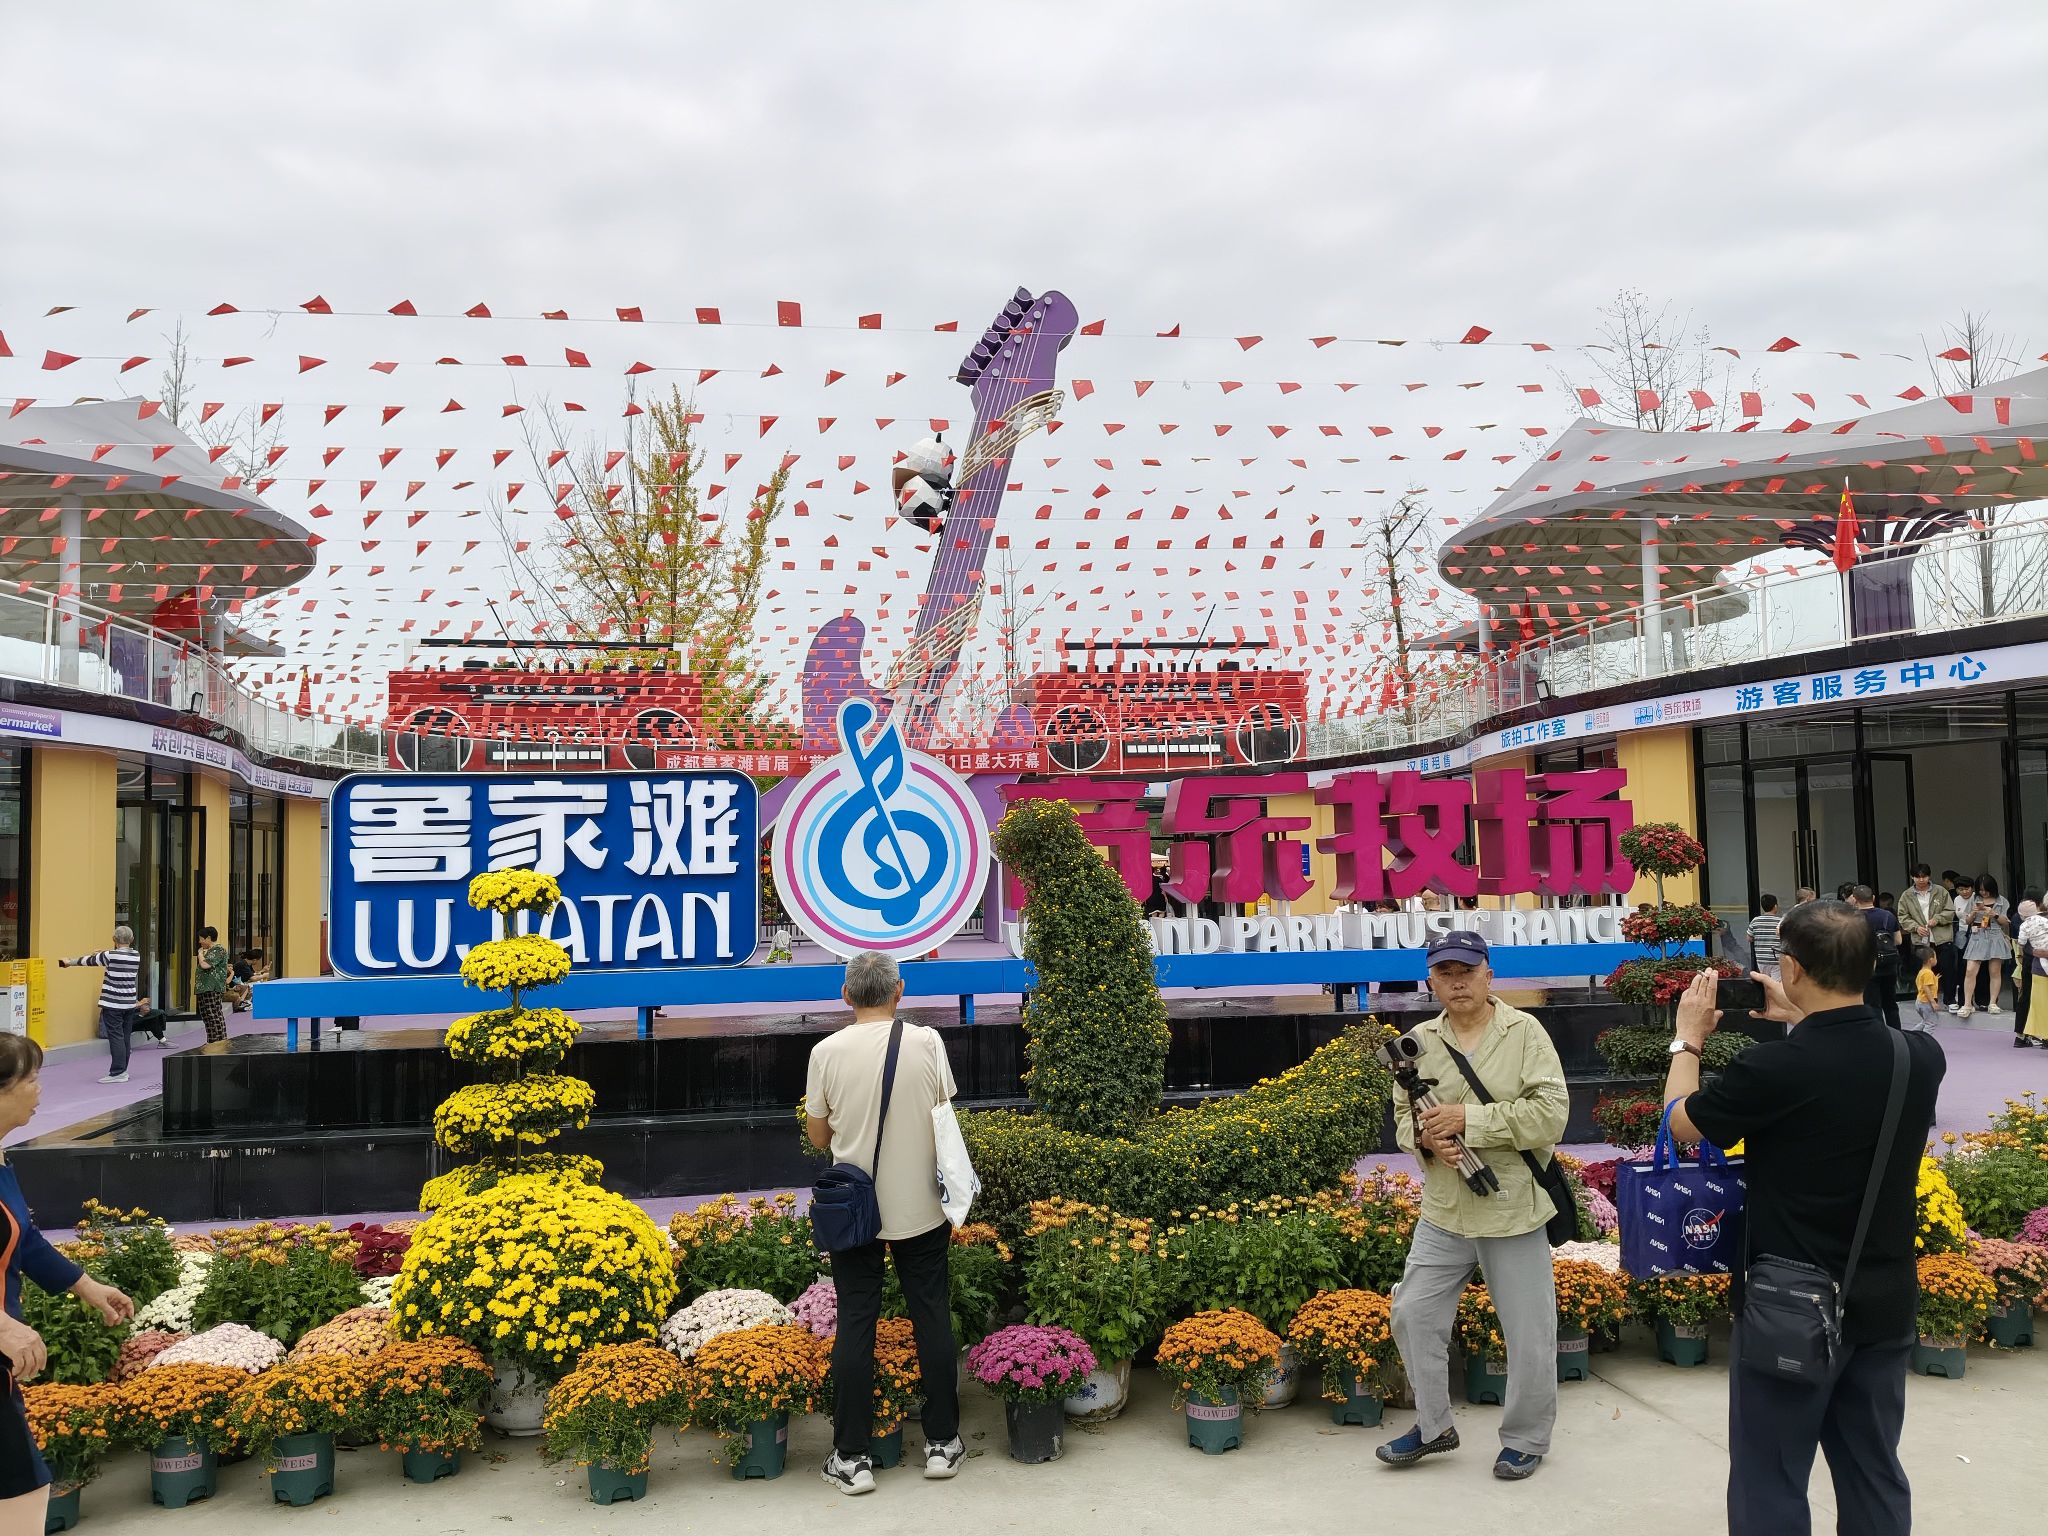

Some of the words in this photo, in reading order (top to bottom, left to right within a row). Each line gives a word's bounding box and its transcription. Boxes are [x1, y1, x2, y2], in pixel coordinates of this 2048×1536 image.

[1736, 655, 1987, 711] 游客服务中心
[1501, 719, 1566, 748] 旅拍工作室
[152, 728, 205, 760] 联创共富
[666, 755, 789, 772] 成都鲁家滩首届
[1407, 754, 1451, 771] 汉服租售
[349, 780, 740, 882] 鲁家滩
[1232, 914, 1344, 953] PARK
[1361, 910, 1493, 949] MUSIC
[1644, 1185, 1661, 1199] NASA
[1673, 1182, 1692, 1197] NASA
[1706, 1181, 1724, 1195] NASA
[1647, 1211, 1665, 1226] NASA
[1685, 1223, 1718, 1235] NASA
[1649, 1238, 1668, 1253] NASA
[1712, 1259, 1729, 1272] NASA
[1191, 1403, 1238, 1419] FLOWERS
[152, 1457, 199, 1470] LOWERS
